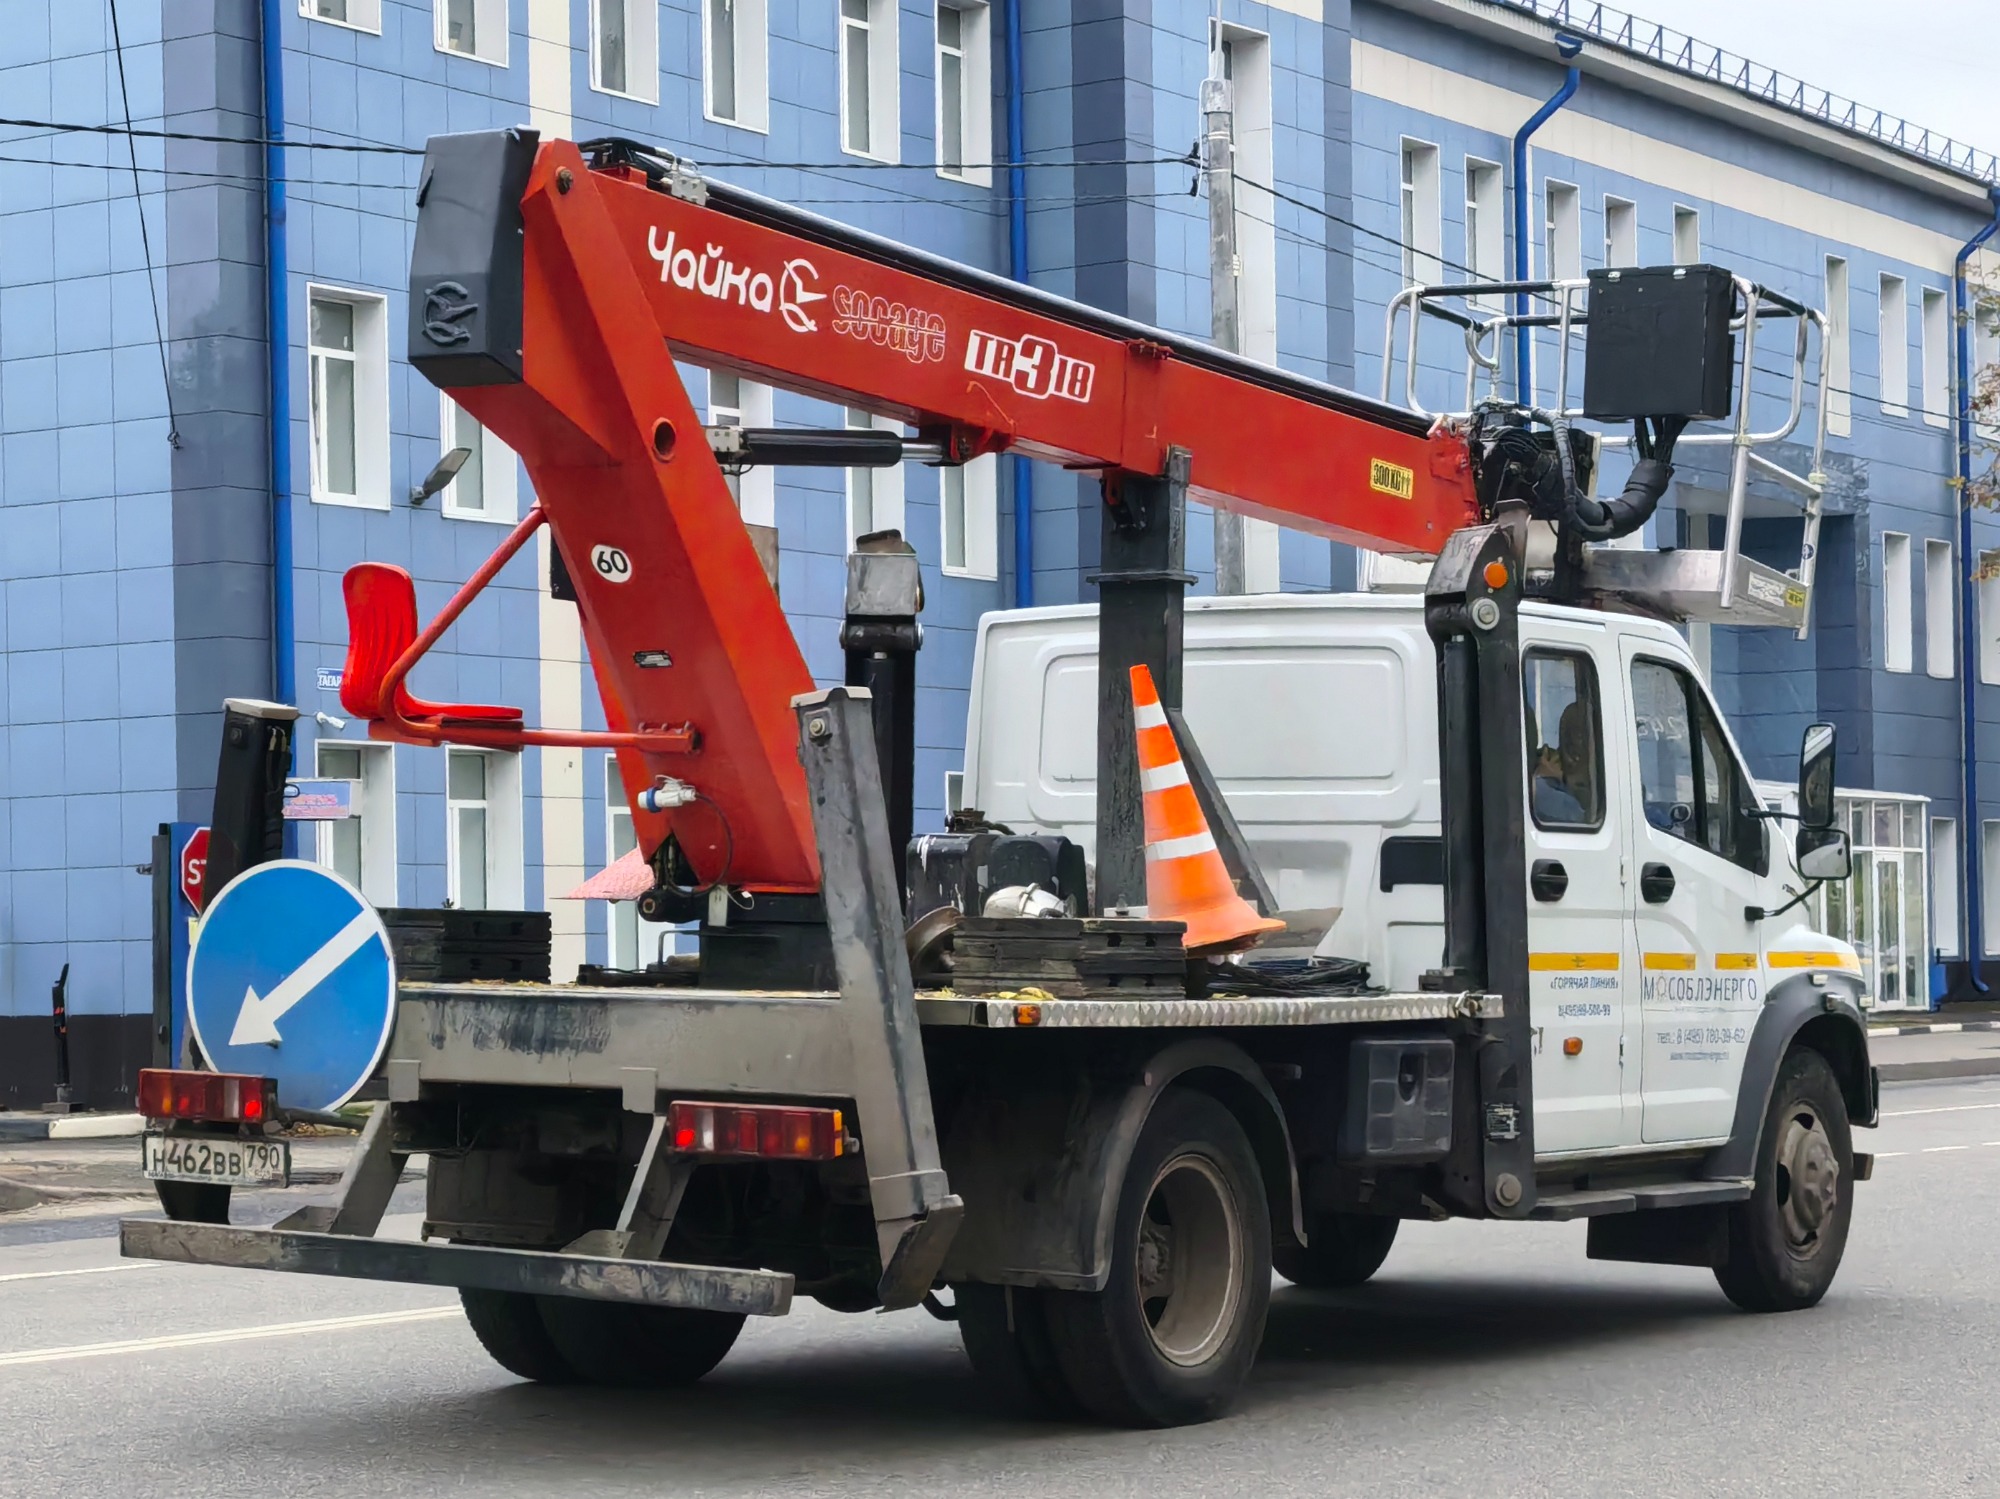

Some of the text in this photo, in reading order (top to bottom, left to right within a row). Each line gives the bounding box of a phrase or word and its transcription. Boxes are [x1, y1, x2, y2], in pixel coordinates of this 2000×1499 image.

[646, 225, 773, 312] Чайка
[1374, 463, 1390, 488] 300
[597, 550, 628, 574] 60
[319, 674, 342, 687] ГАГАР
[187, 858, 207, 885] S
[246, 1144, 279, 1169] 790
